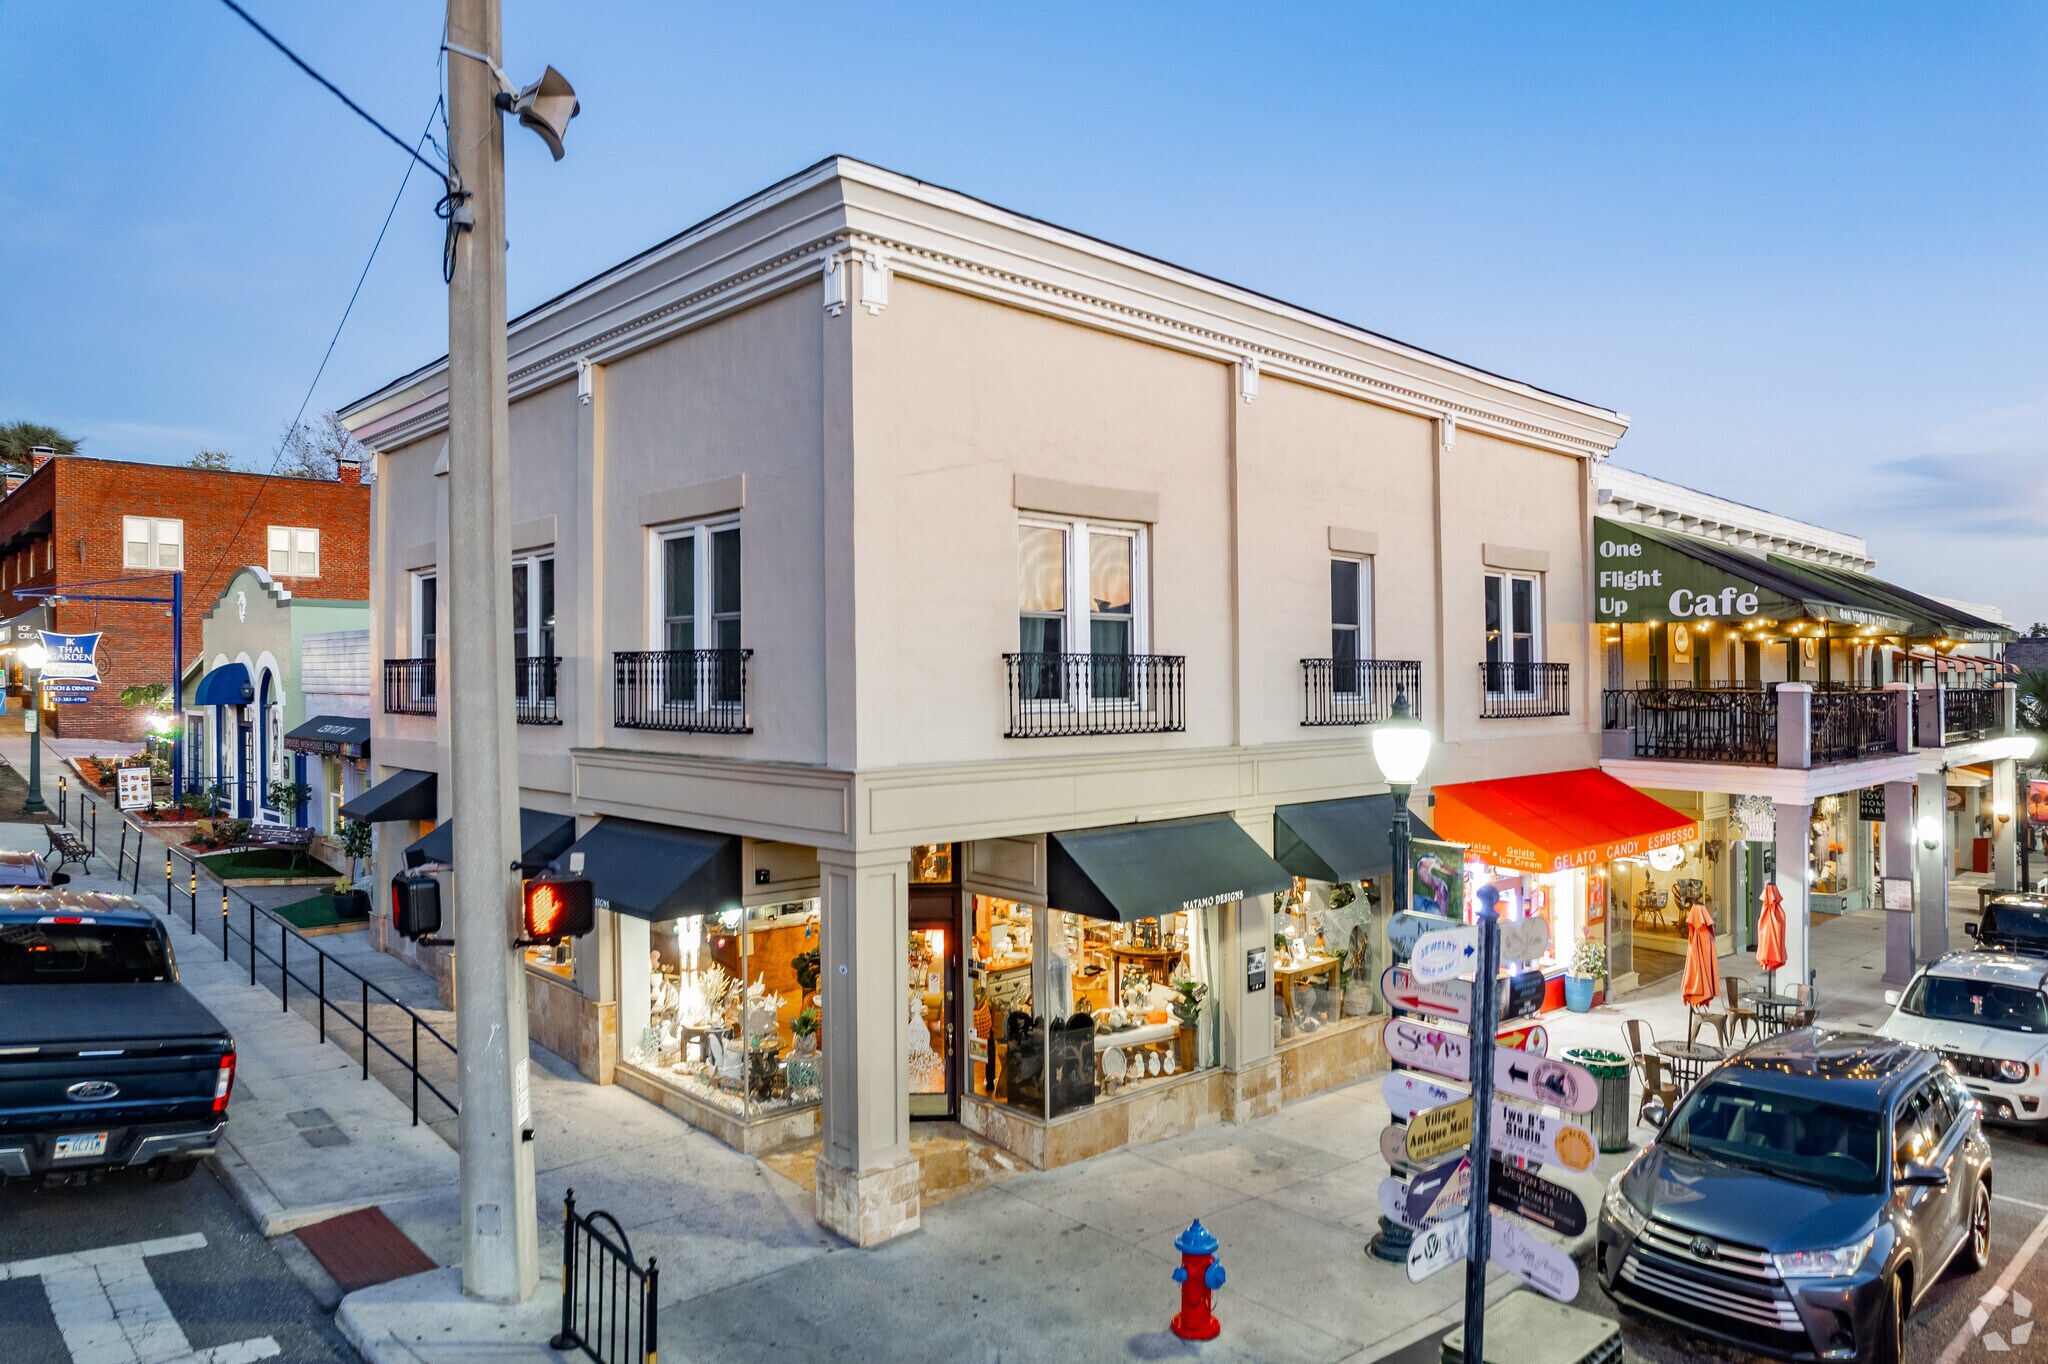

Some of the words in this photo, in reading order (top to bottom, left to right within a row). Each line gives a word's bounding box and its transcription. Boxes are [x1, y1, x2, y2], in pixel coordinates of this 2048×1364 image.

[1599, 540, 1642, 558] One
[1600, 569, 1662, 591] Flight
[1600, 597, 1629, 617] Up
[1668, 586, 1759, 617] Café
[1839, 607, 1851, 620] One
[58, 646, 84, 654] THAI
[66, 638, 75, 646] JK
[48, 653, 92, 661] GARDEN
[324, 742, 339, 752] REALTY
[1861, 800, 1885, 808] HOM
[1506, 846, 1535, 858] Gelato
[1554, 849, 1597, 871] GELATO
[1606, 840, 1640, 859] CANDY
[1648, 827, 1695, 849] ESPRESSO
[1499, 855, 1512, 865] Ice
[1514, 857, 1543, 870] Cream
[594, 897, 610, 910] SIGNS
[1182, 895, 1214, 911] MATAMO
[1215, 889, 1244, 905] DESIGNS
[1420, 939, 1457, 959] JEWELRY
[1409, 981, 1431, 994] Center
[1431, 985, 1442, 996] for
[1442, 987, 1454, 998] the
[1424, 1108, 1457, 1129] Village
[1502, 1106, 1523, 1126] Two
[1409, 1128, 1448, 1149] Antique
[1449, 1115, 1469, 1136] Mall
[1505, 1121, 1542, 1143] Studio
[1502, 1163, 1537, 1189] DESIGN
[1539, 1177, 1573, 1205] SOUTH
[1518, 1182, 1555, 1209] HOMES
